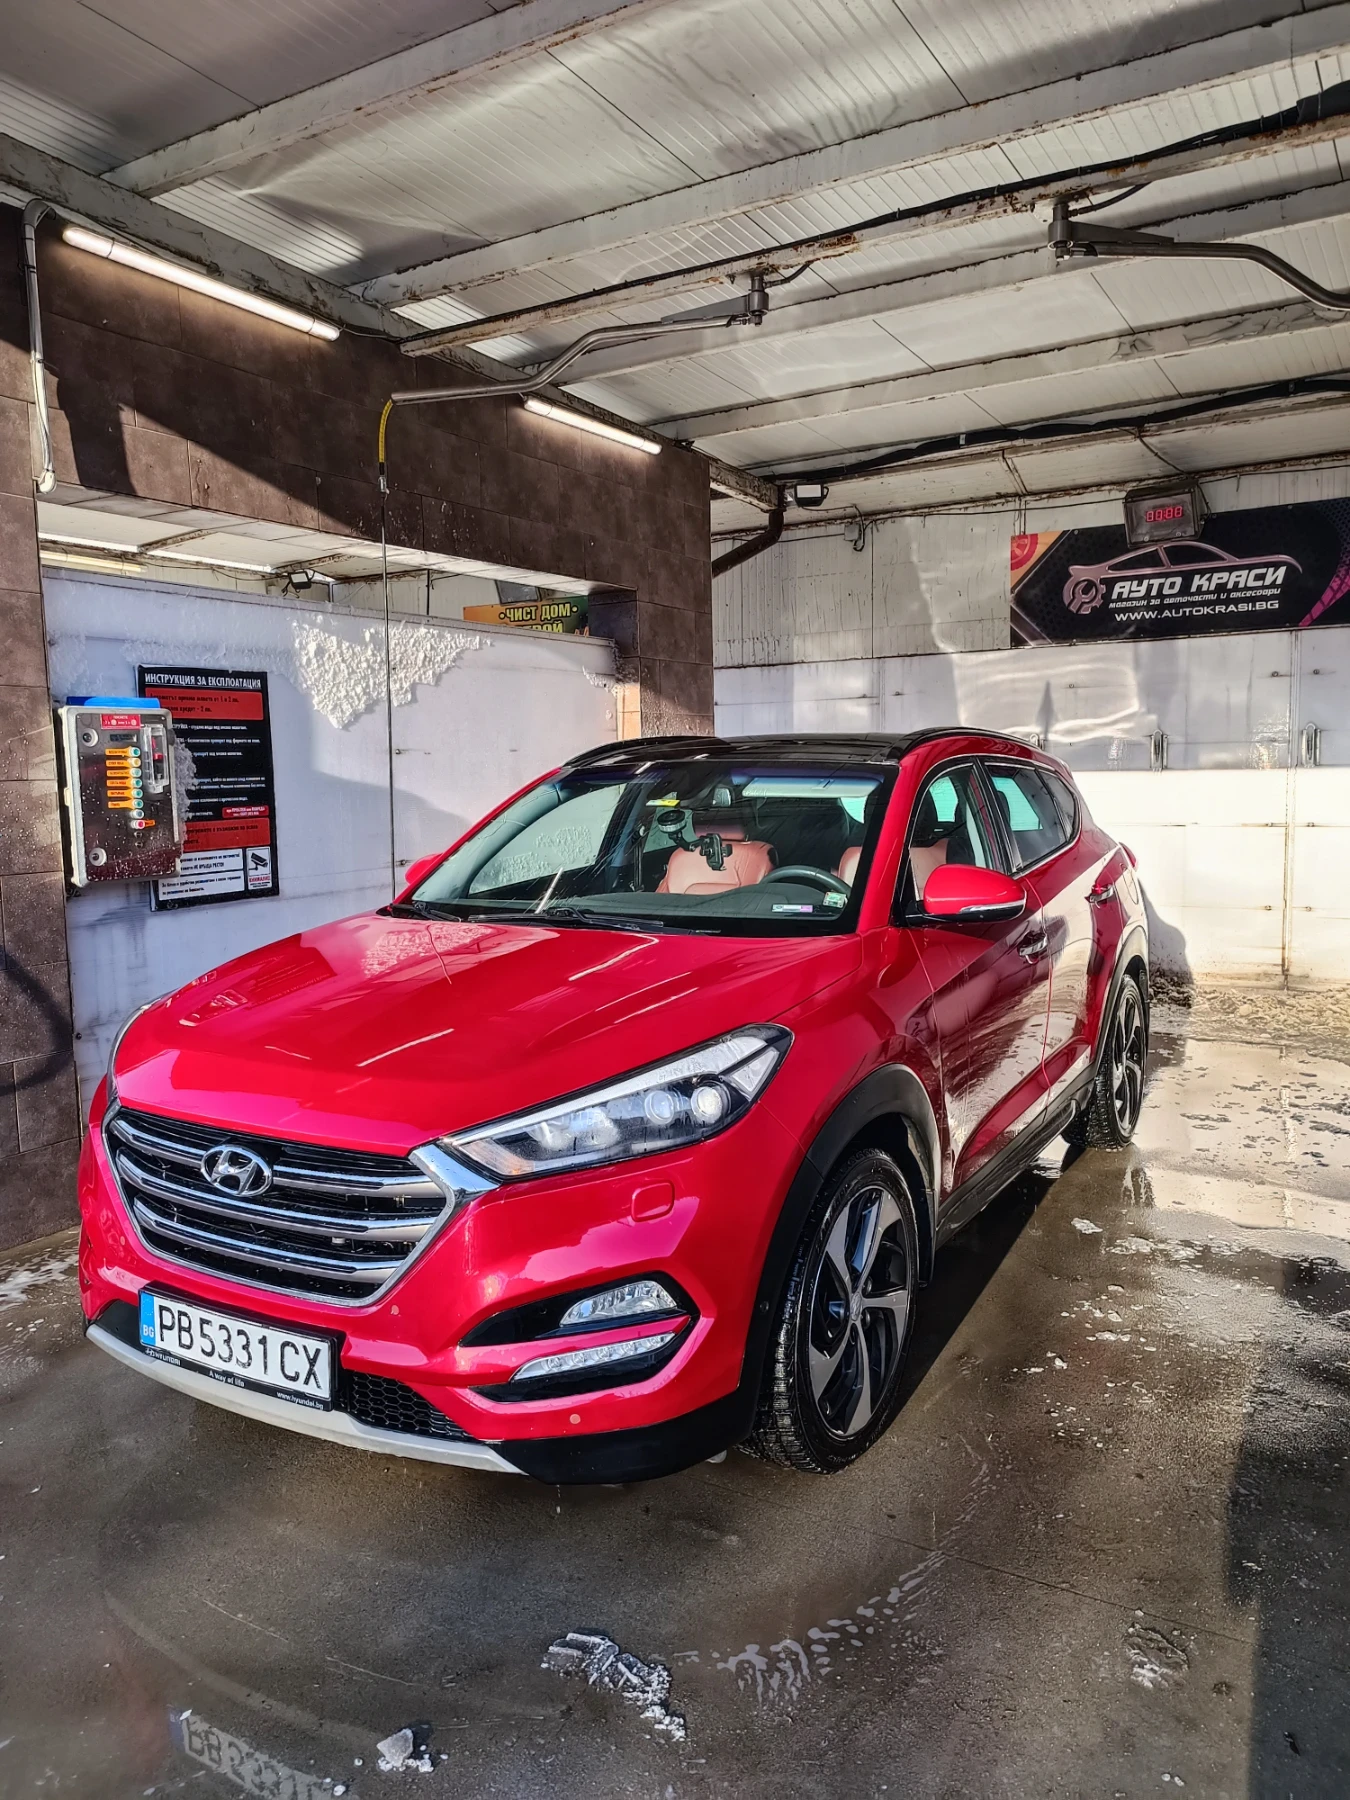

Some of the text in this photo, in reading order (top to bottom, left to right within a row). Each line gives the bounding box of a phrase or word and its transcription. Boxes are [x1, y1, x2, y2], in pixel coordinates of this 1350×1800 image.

[1111, 566, 1287, 600] АУТО КРАСИ
[506, 603, 571, 622] ЧИСТ ДОМ
[1115, 600, 1279, 621] WWW.AUTOKRASI.BG
[145, 673, 261, 689] ИНСТРУКЦИЯ ЗА ЕКСПЛОАТАЦИЯ
[142, 1324, 155, 1338] BG
